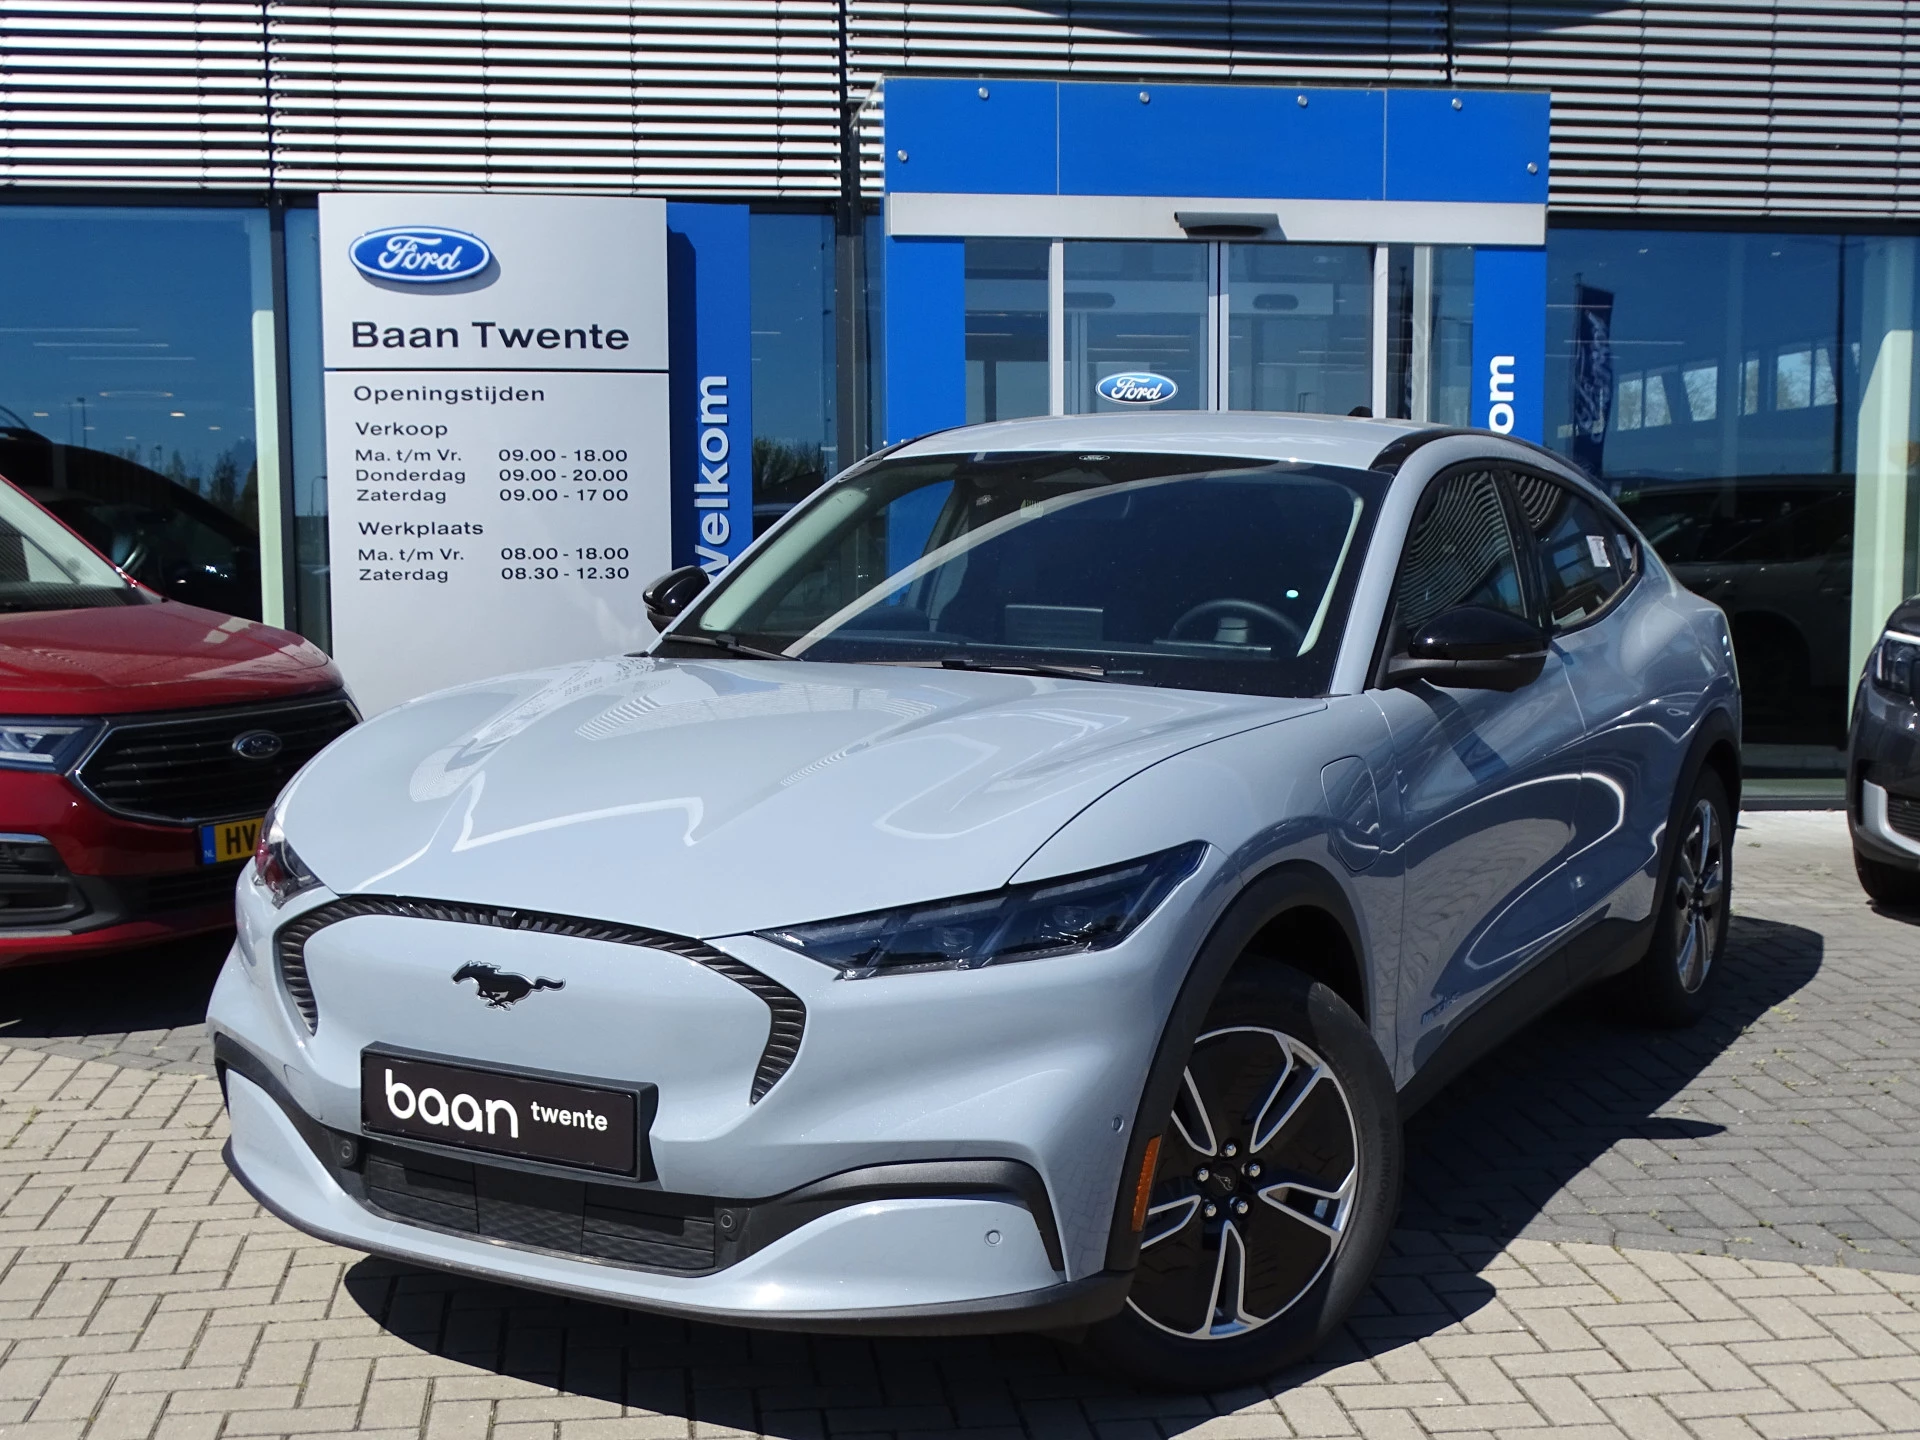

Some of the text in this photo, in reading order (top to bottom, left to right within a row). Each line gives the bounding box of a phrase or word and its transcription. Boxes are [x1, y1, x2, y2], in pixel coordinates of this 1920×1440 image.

[378, 235, 463, 270] Ford
[352, 321, 629, 350] Baan Twente
[353, 385, 545, 405] Openingstijden
[1111, 376, 1162, 400] Ford
[355, 421, 448, 439] Verkoop
[355, 449, 391, 462] Ma.
[396, 449, 431, 463] t/m
[437, 449, 462, 462] Vr.
[498, 449, 556, 462] 09.00
[573, 449, 628, 462] 18.00
[356, 469, 466, 484] Donderdag
[499, 469, 556, 482] 09.00
[572, 469, 628, 482] 20.00
[356, 489, 447, 504] Zaterdag
[499, 488, 558, 502] 09.00
[358, 521, 484, 539] Werkplaats
[358, 548, 394, 562] Ma.
[399, 548, 434, 563] t/m
[439, 548, 464, 561] Vr.
[500, 547, 558, 561] 08.00
[576, 547, 629, 561] 18.00
[359, 568, 449, 584] Zaterdag
[501, 567, 559, 580] 08.30
[576, 567, 630, 580] 12.30
[385, 1068, 608, 1139] baan twente
